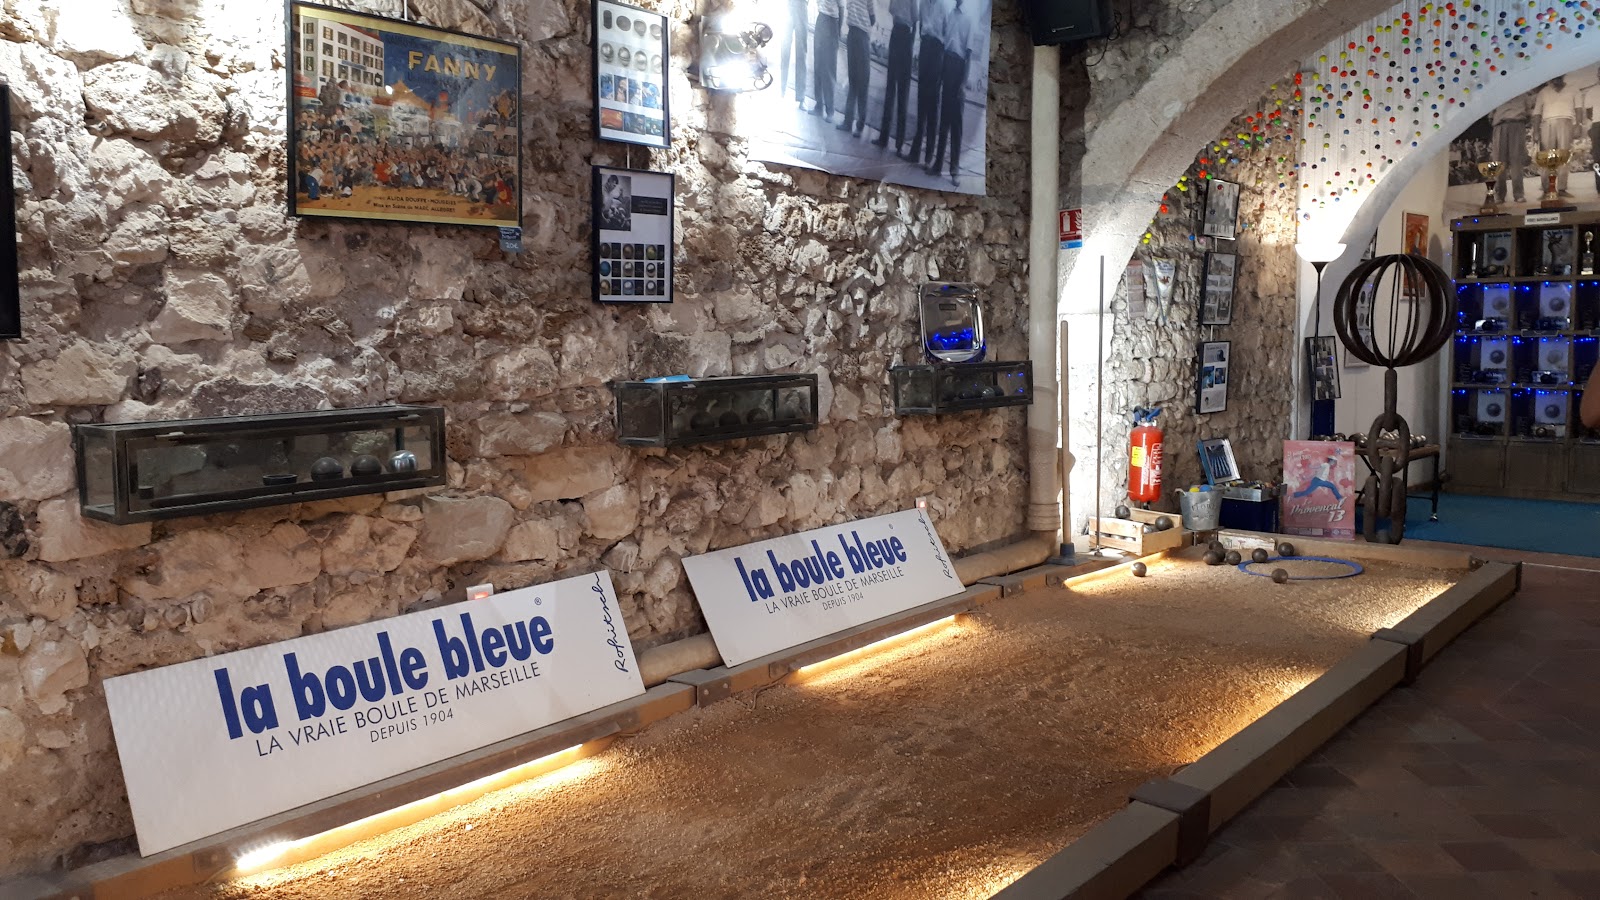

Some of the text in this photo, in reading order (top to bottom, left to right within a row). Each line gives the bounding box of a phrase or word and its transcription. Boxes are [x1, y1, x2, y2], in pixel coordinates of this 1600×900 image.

[408, 50, 497, 82] FANNY
[1328, 510, 1346, 523] 13
[734, 530, 907, 603] la boule bleue
[765, 566, 905, 614] LA VRAIE BOULE DE MARSEILLE
[822, 592, 864, 611] DEPUIS 1904
[214, 612, 554, 740] la boule bleue
[256, 661, 541, 757] LA VRAIE BOULE DE MARSEILLE
[370, 708, 455, 743] DEPUIS 1904
